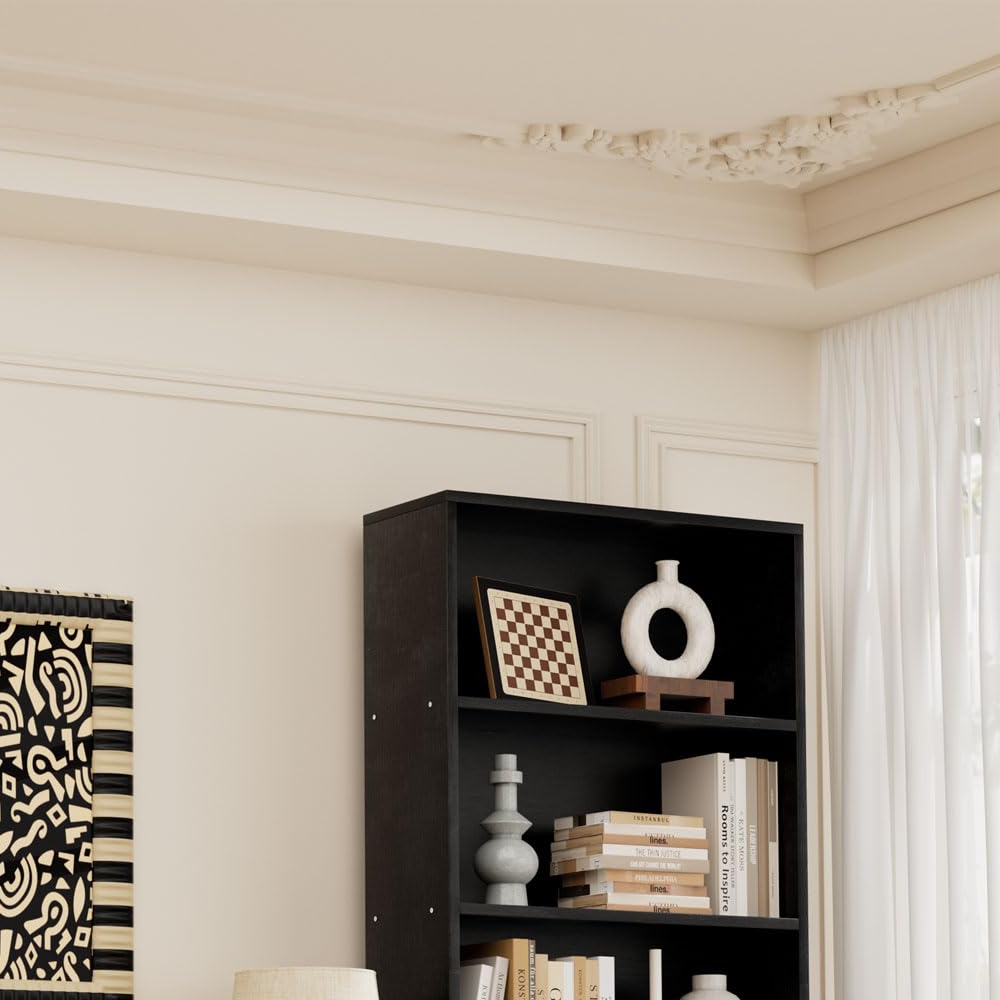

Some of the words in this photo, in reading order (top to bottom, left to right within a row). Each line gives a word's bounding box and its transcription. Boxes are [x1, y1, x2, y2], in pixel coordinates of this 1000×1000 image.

[721, 805, 729, 848] Rooms
[722, 852, 729, 865] to
[720, 869, 730, 912] Inspire
